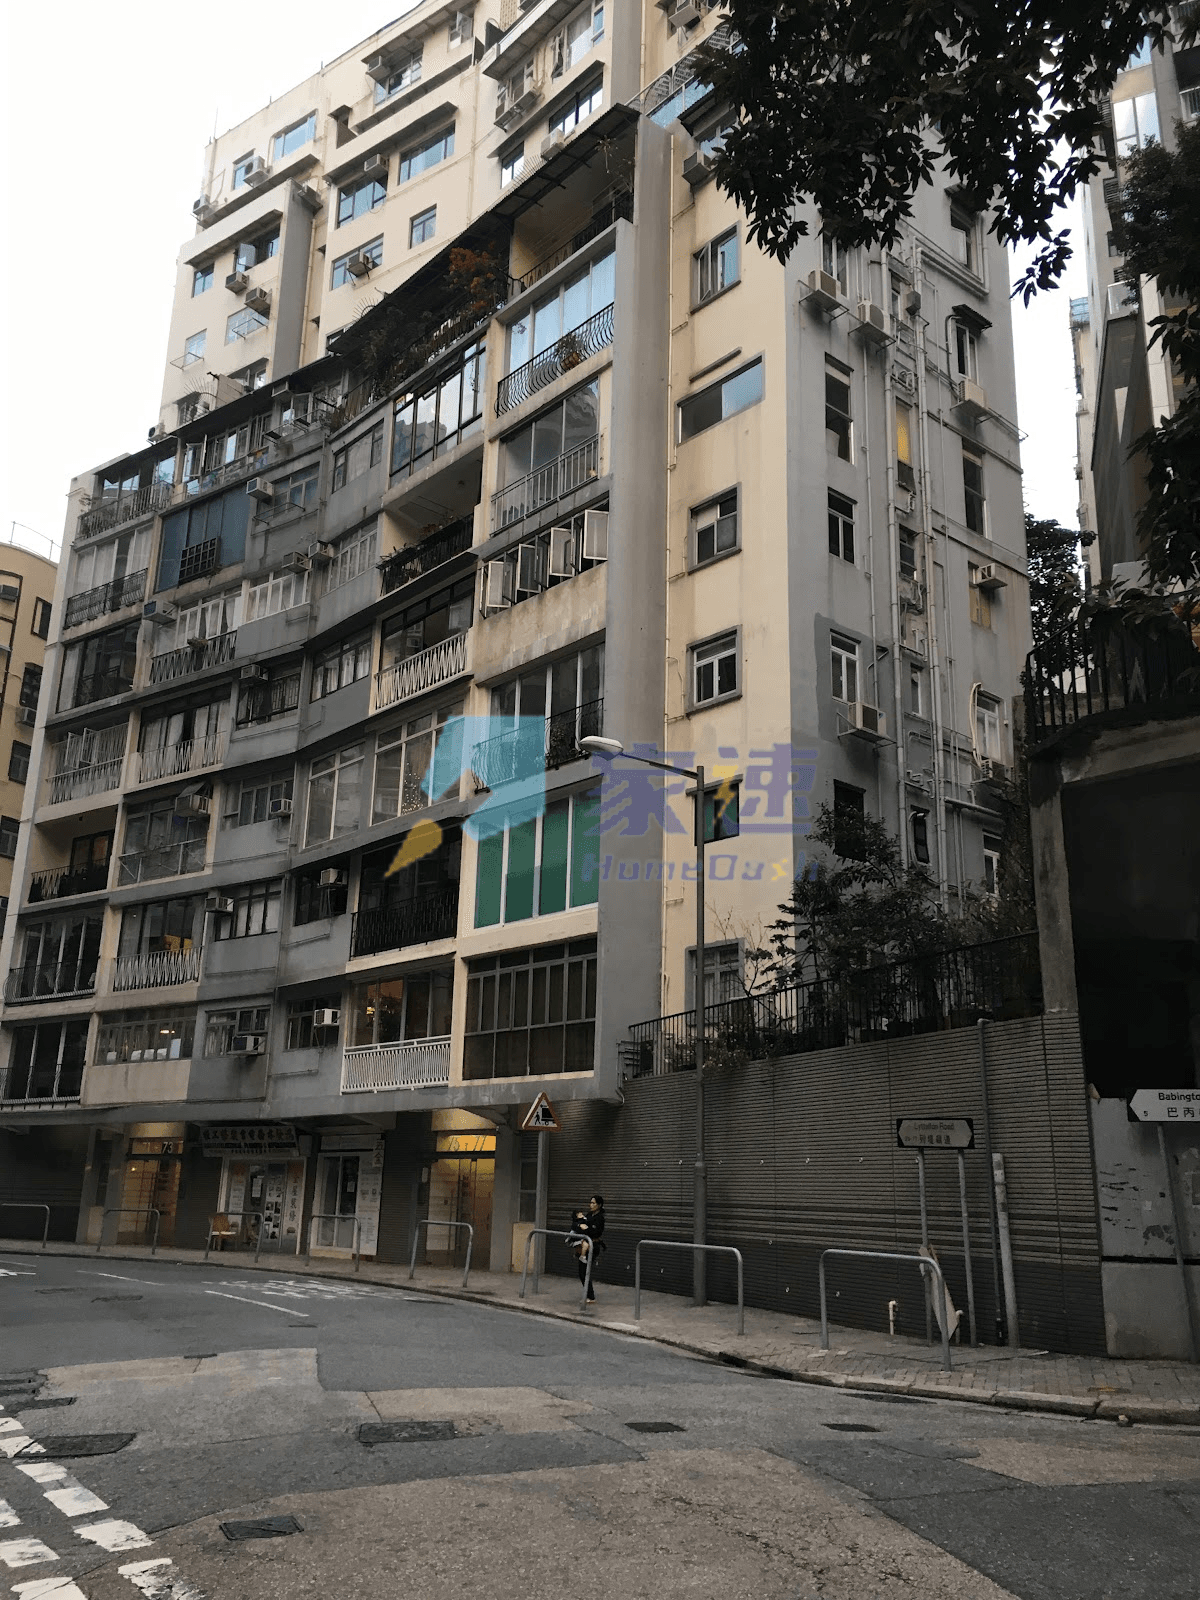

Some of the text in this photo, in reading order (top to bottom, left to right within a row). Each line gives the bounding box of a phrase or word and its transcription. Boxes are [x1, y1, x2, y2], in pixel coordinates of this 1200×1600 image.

[1167, 1107, 1200, 1118] 巴丙
[940, 1122, 955, 1131] Road
[374, 1140, 384, 1165] 五金
